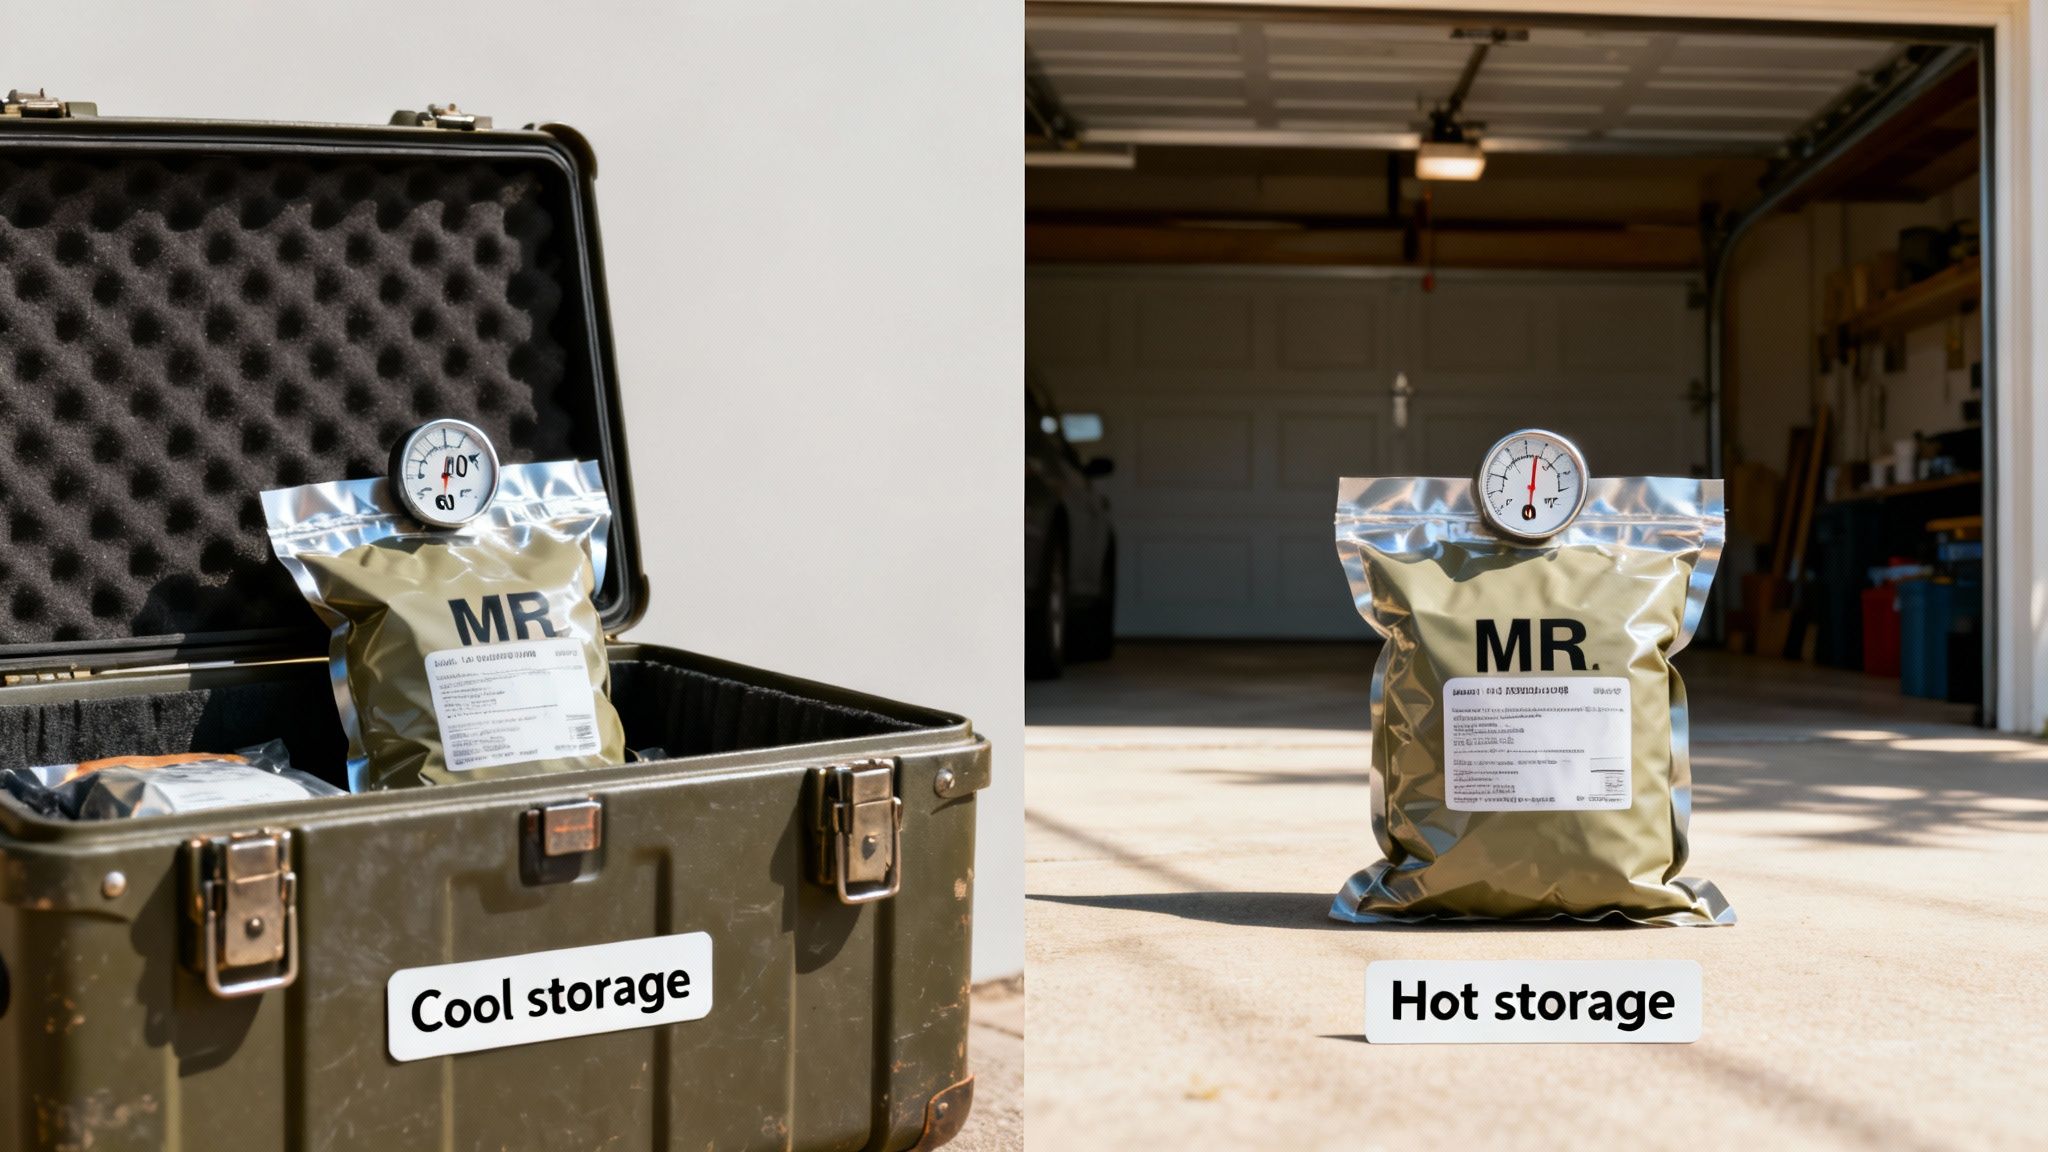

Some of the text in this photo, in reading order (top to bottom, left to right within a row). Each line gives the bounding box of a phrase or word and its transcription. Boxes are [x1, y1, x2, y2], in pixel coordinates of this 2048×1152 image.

[411, 968, 691, 1033] Cool storage
[1392, 980, 1675, 1032] Hot storage
